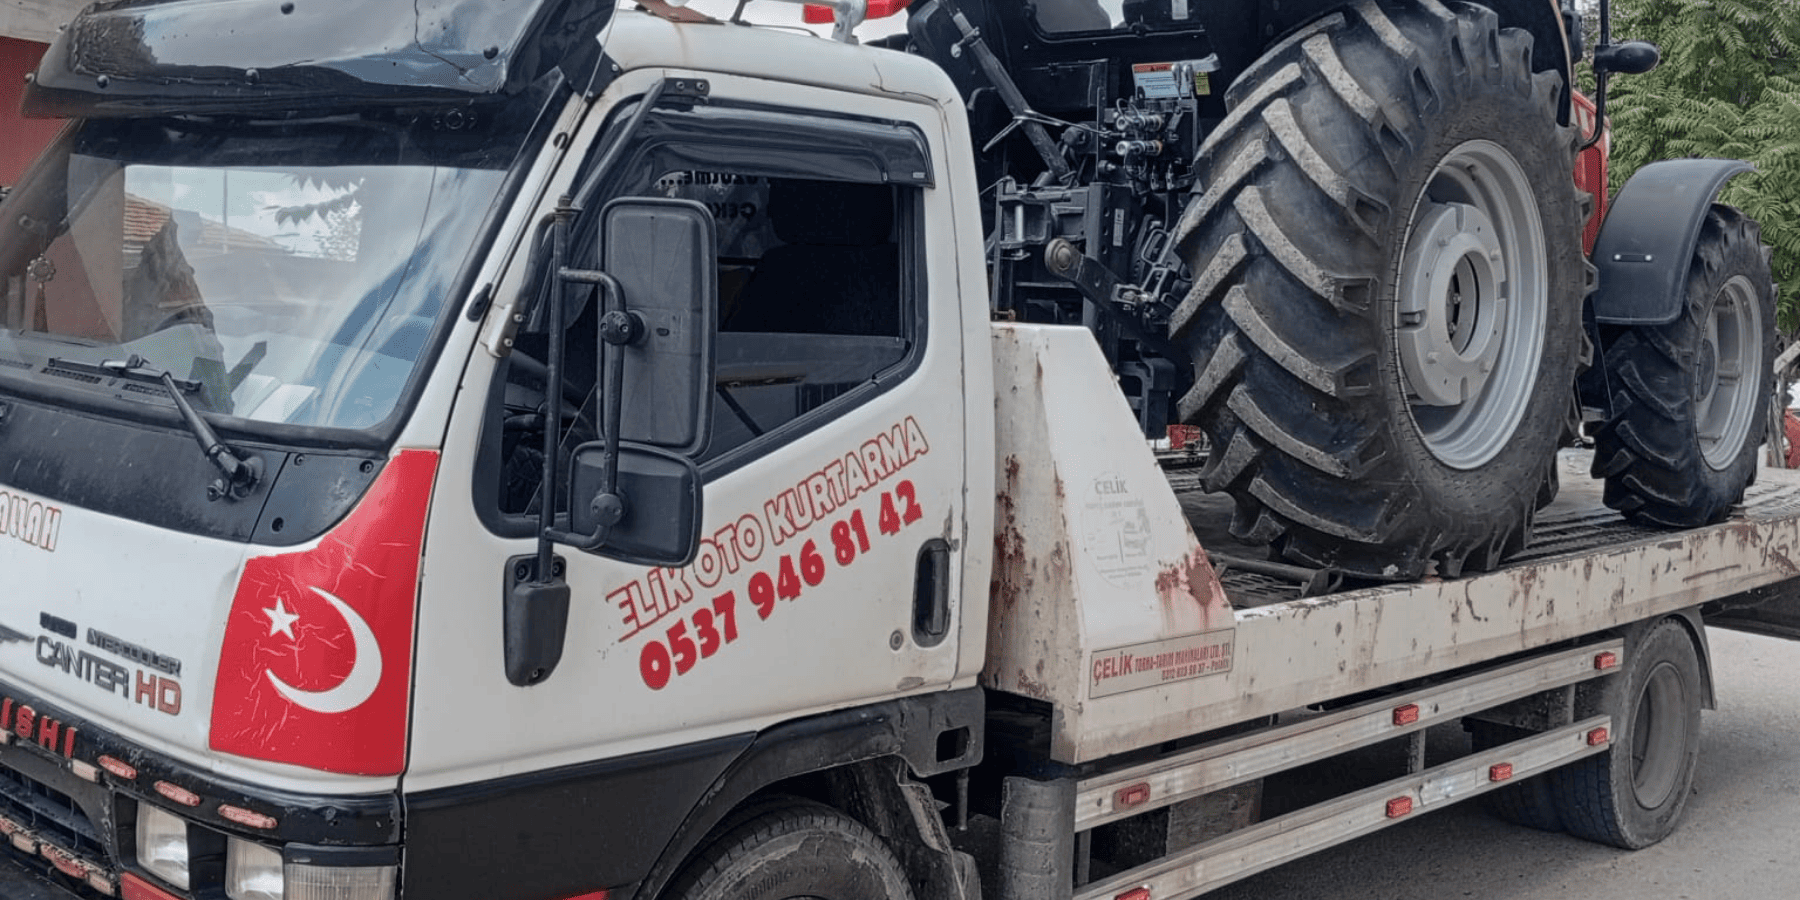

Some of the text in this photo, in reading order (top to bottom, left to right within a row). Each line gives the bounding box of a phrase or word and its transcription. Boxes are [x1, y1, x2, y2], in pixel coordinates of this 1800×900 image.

[692, 513, 765, 588] OTO
[764, 415, 929, 546] KURTARMA
[639, 479, 923, 690] 0537 946 81 42
[36, 635, 182, 717] CANTER HD
[1093, 650, 1133, 687] ÇELİK
[0, 697, 78, 760] ISHI
